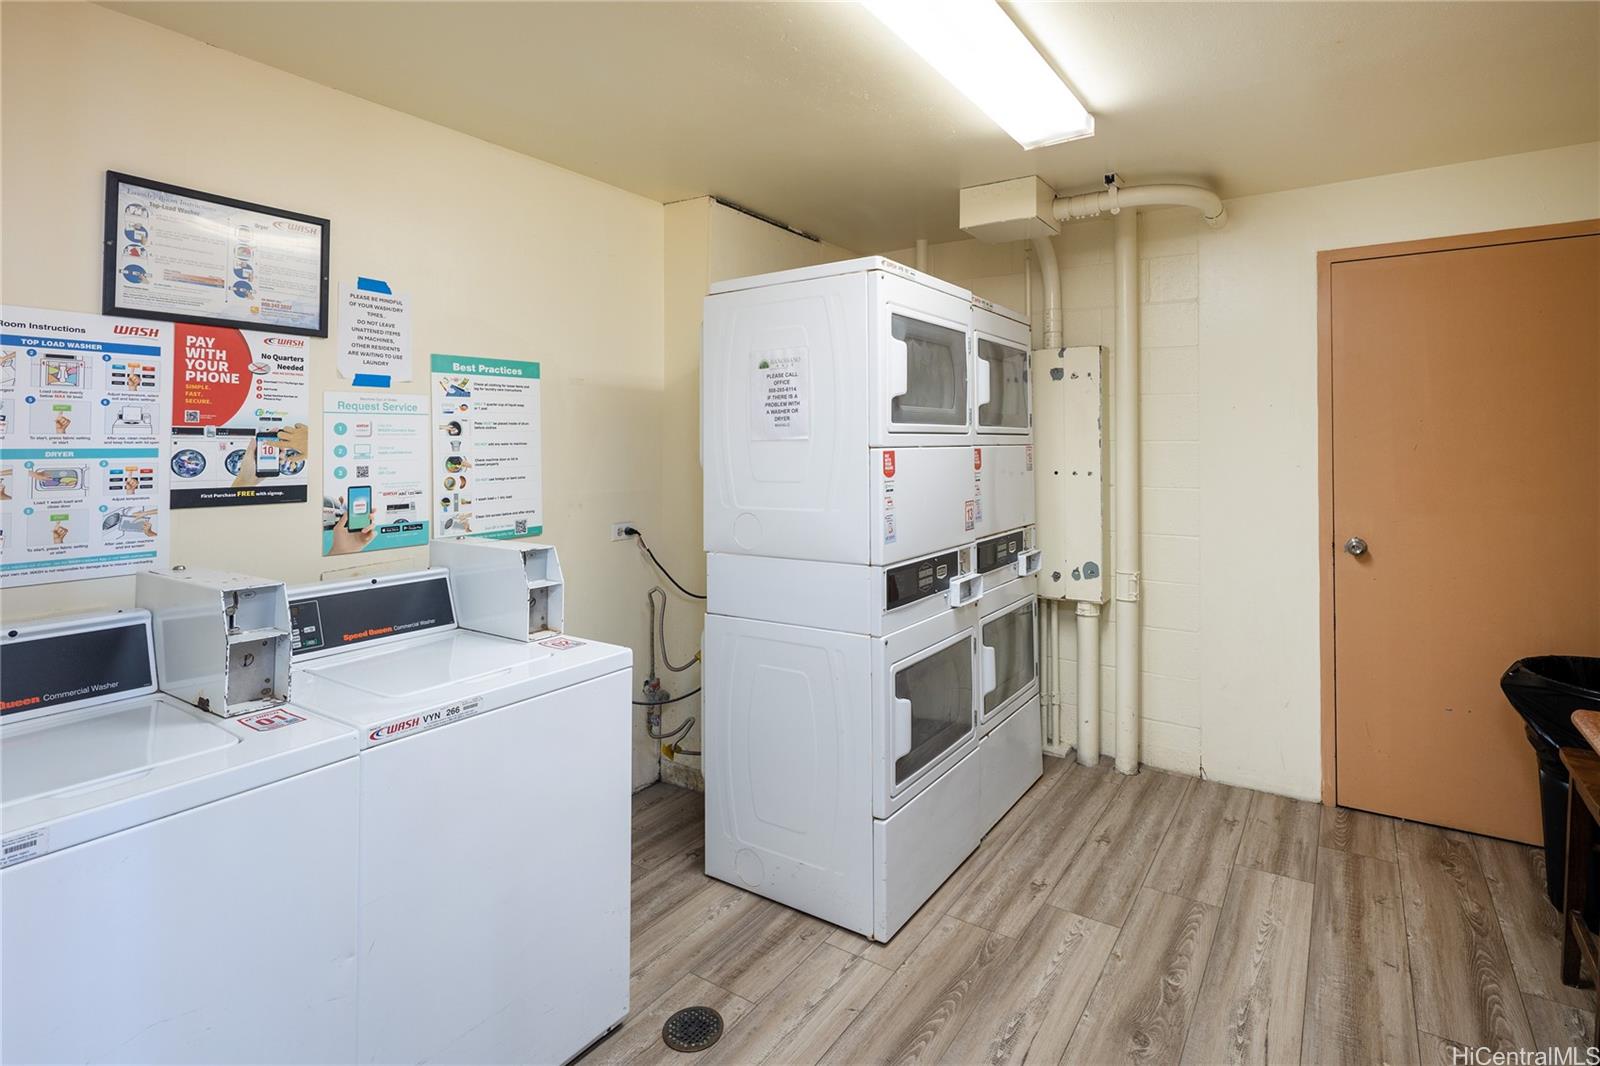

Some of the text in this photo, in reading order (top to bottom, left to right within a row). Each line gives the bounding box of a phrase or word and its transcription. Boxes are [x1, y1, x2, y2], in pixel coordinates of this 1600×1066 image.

[150, 202, 200, 216] Top-Load Washer
[288, 223, 317, 234] WASH
[374, 304, 403, 312] WASH/DRY
[29, 322, 86, 334] Instructions
[114, 325, 160, 338] WASH
[67, 342, 102, 350] WASHER
[186, 336, 215, 348] PAY
[186, 348, 227, 360] WITH
[272, 354, 304, 362] Quarters
[185, 359, 229, 372] YOUR
[453, 363, 522, 375] Best Practices
[186, 370, 240, 384] PHONE
[338, 401, 417, 412] Request Service
[263, 446, 273, 454] 10
[967, 508, 973, 521] 13
[343, 630, 368, 641] Speed
[369, 626, 393, 635] Queen
[394, 622, 419, 631] Commercial
[43, 687, 89, 702] Commercial
[91, 681, 119, 692] Washer
[387, 706, 460, 734] WASH VYN 266
